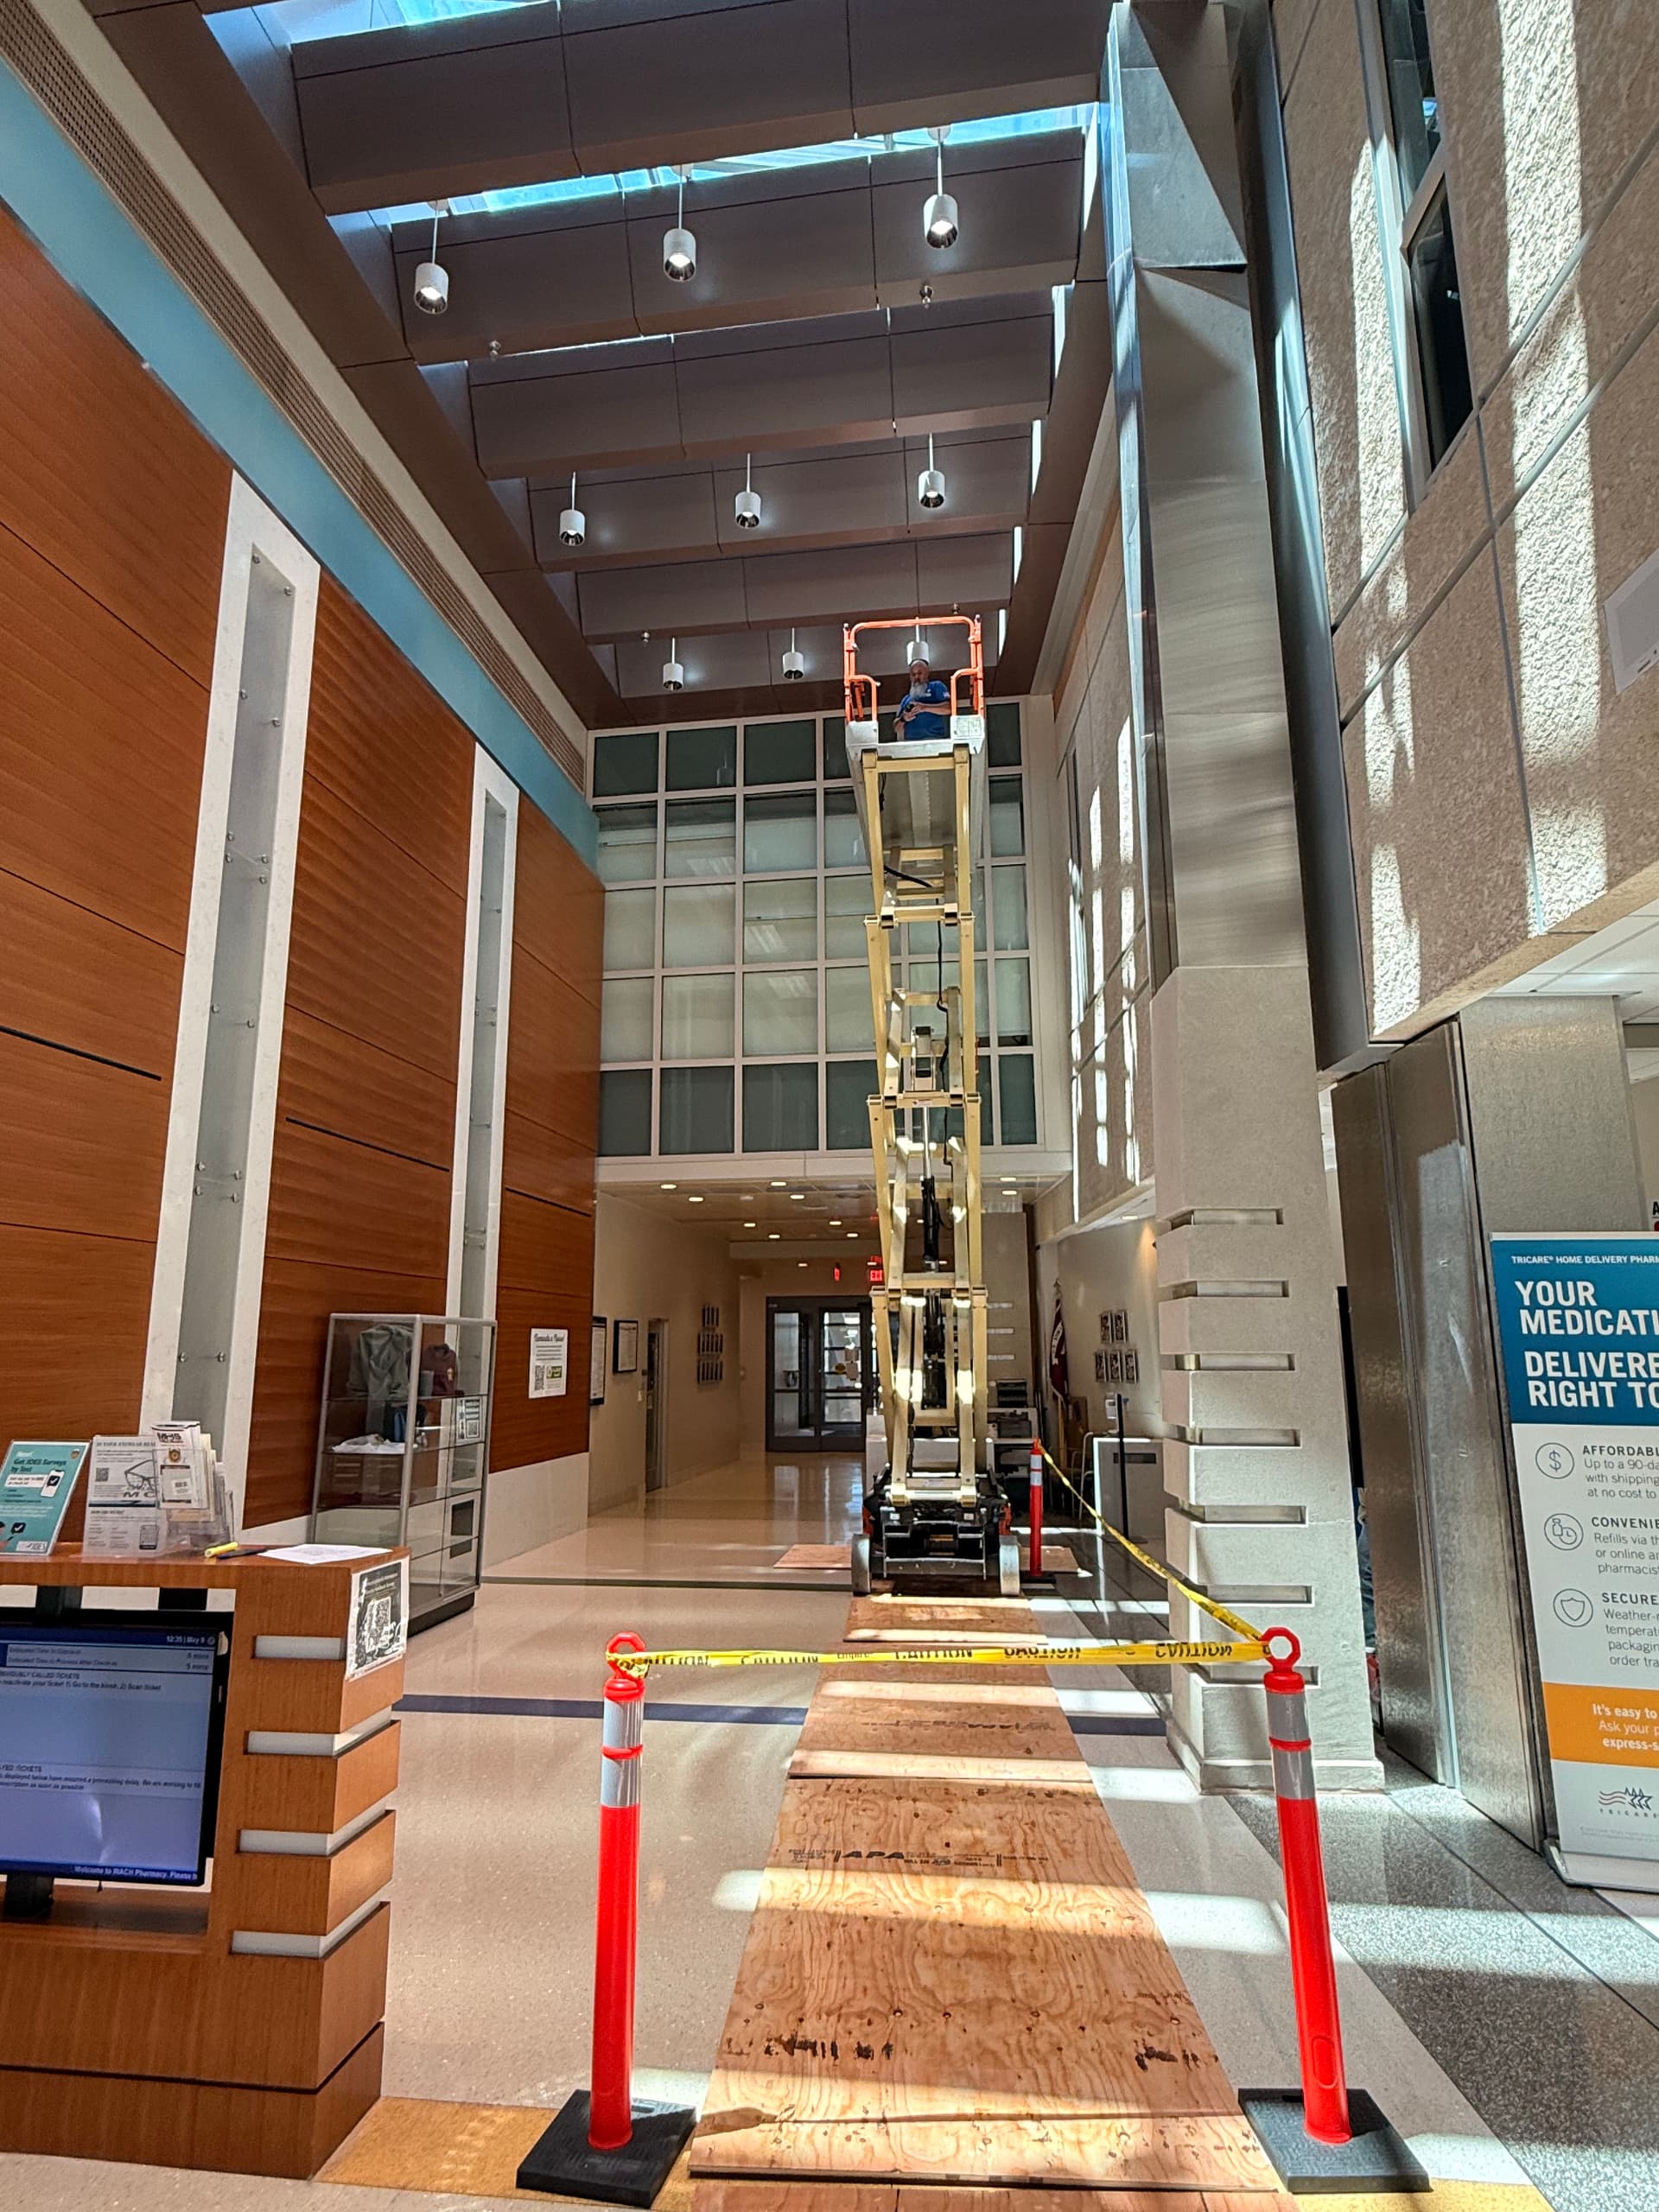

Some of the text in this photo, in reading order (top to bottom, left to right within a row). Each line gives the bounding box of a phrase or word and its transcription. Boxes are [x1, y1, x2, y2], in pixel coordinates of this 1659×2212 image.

[1556, 1255, 1583, 1264] HOME
[1585, 1255, 1628, 1264] DELIVERY
[1515, 1281, 1597, 1306] YOUR
[1528, 1380, 1659, 1408] RIGHT TO
[1584, 1459, 1601, 1471] Up
[1604, 1459, 1615, 1469] to
[1586, 1473, 1608, 1484] with
[1587, 1487, 1657, 1499] at no cost to
[1593, 1532, 1629, 1545] Refills
[1630, 1535, 1648, 1545] via
[1595, 1548, 1606, 1558] or
[1610, 1548, 1645, 1560] online
[1601, 1592, 1659, 1605] SECURE
[1610, 1655, 1640, 1667] order
[1592, 1703, 1657, 1719] It's easy to
[1598, 1719, 1621, 1732] Ask
[1623, 1723, 1649, 1736] your
[842, 1851, 905, 1860] APA
